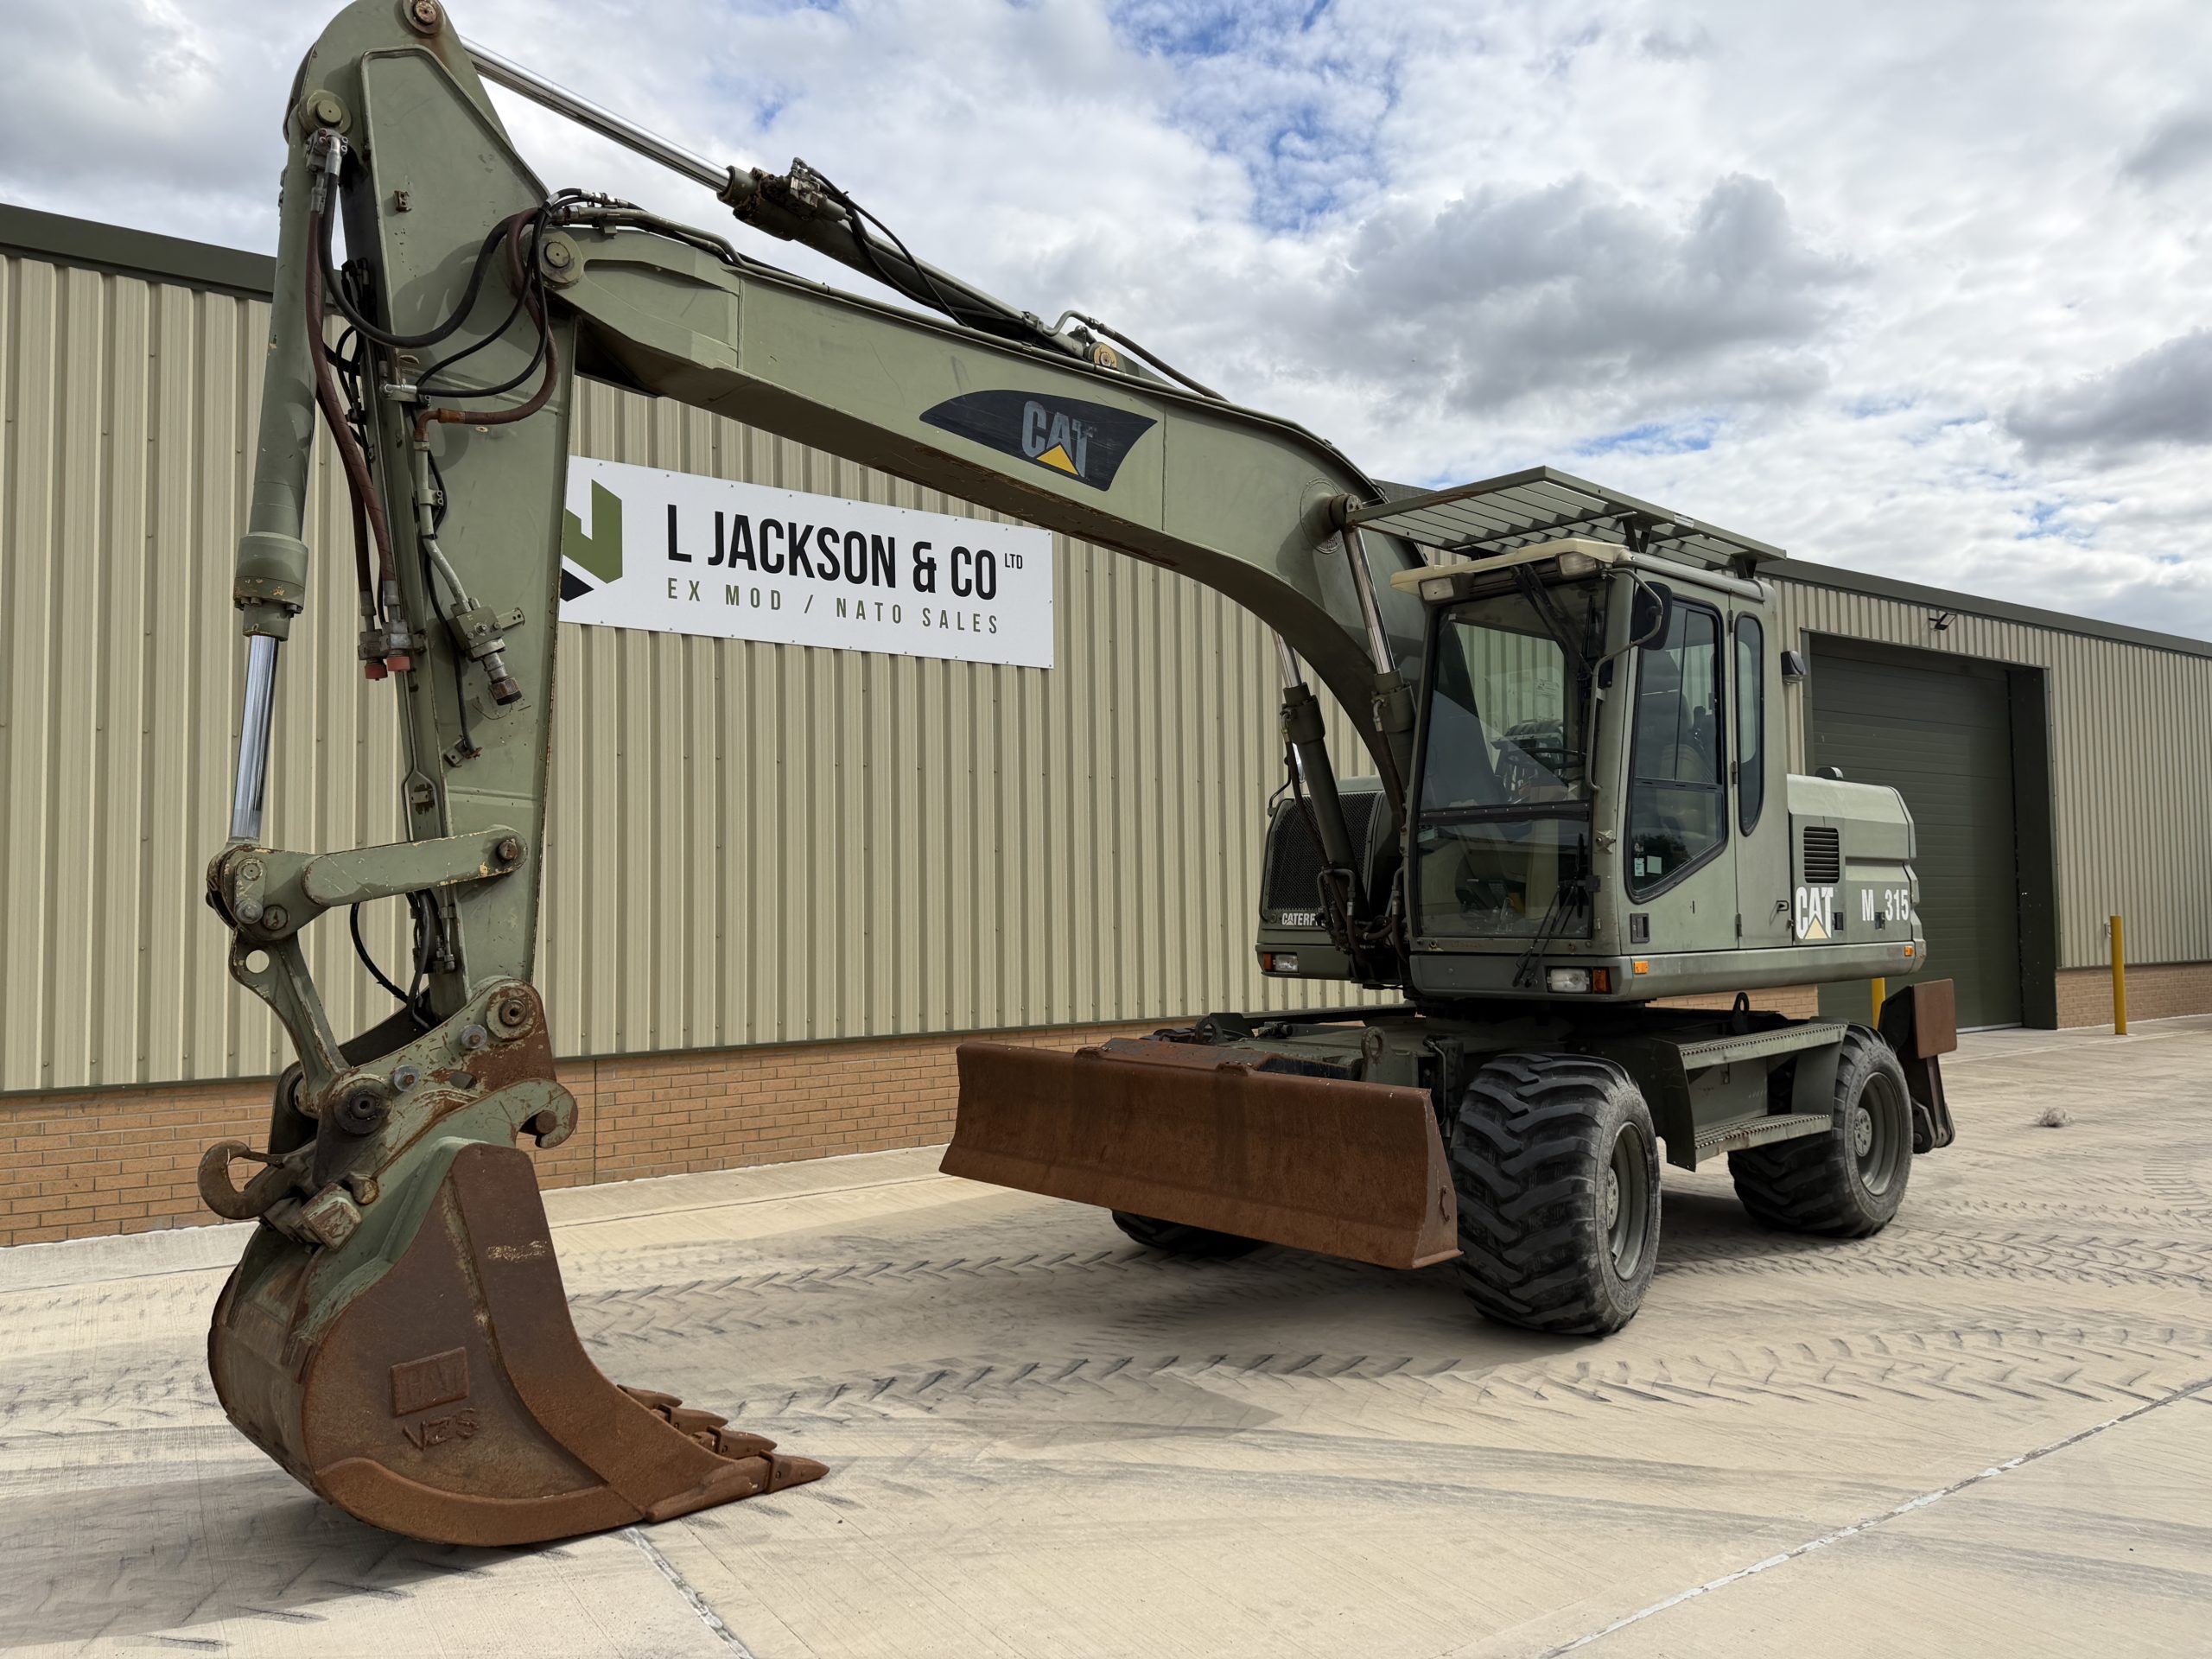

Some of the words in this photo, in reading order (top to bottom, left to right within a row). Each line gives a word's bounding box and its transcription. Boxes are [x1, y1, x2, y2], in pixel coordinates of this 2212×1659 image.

[1021, 400, 1095, 478] CAT
[668, 503, 692, 563] L
[707, 511, 896, 589] JACKSON
[912, 541, 938, 594] &
[950, 545, 997, 601] CO
[1004, 552, 1023, 570] LTD
[668, 577, 701, 602] EX
[725, 584, 781, 611] MOD
[836, 597, 901, 624] NATO
[922, 607, 997, 634] SALES
[1281, 912, 1318, 925] CATERP
[1796, 886, 1833, 939] CAT
[1861, 888, 1874, 921] M
[1885, 888, 1910, 921] 315
